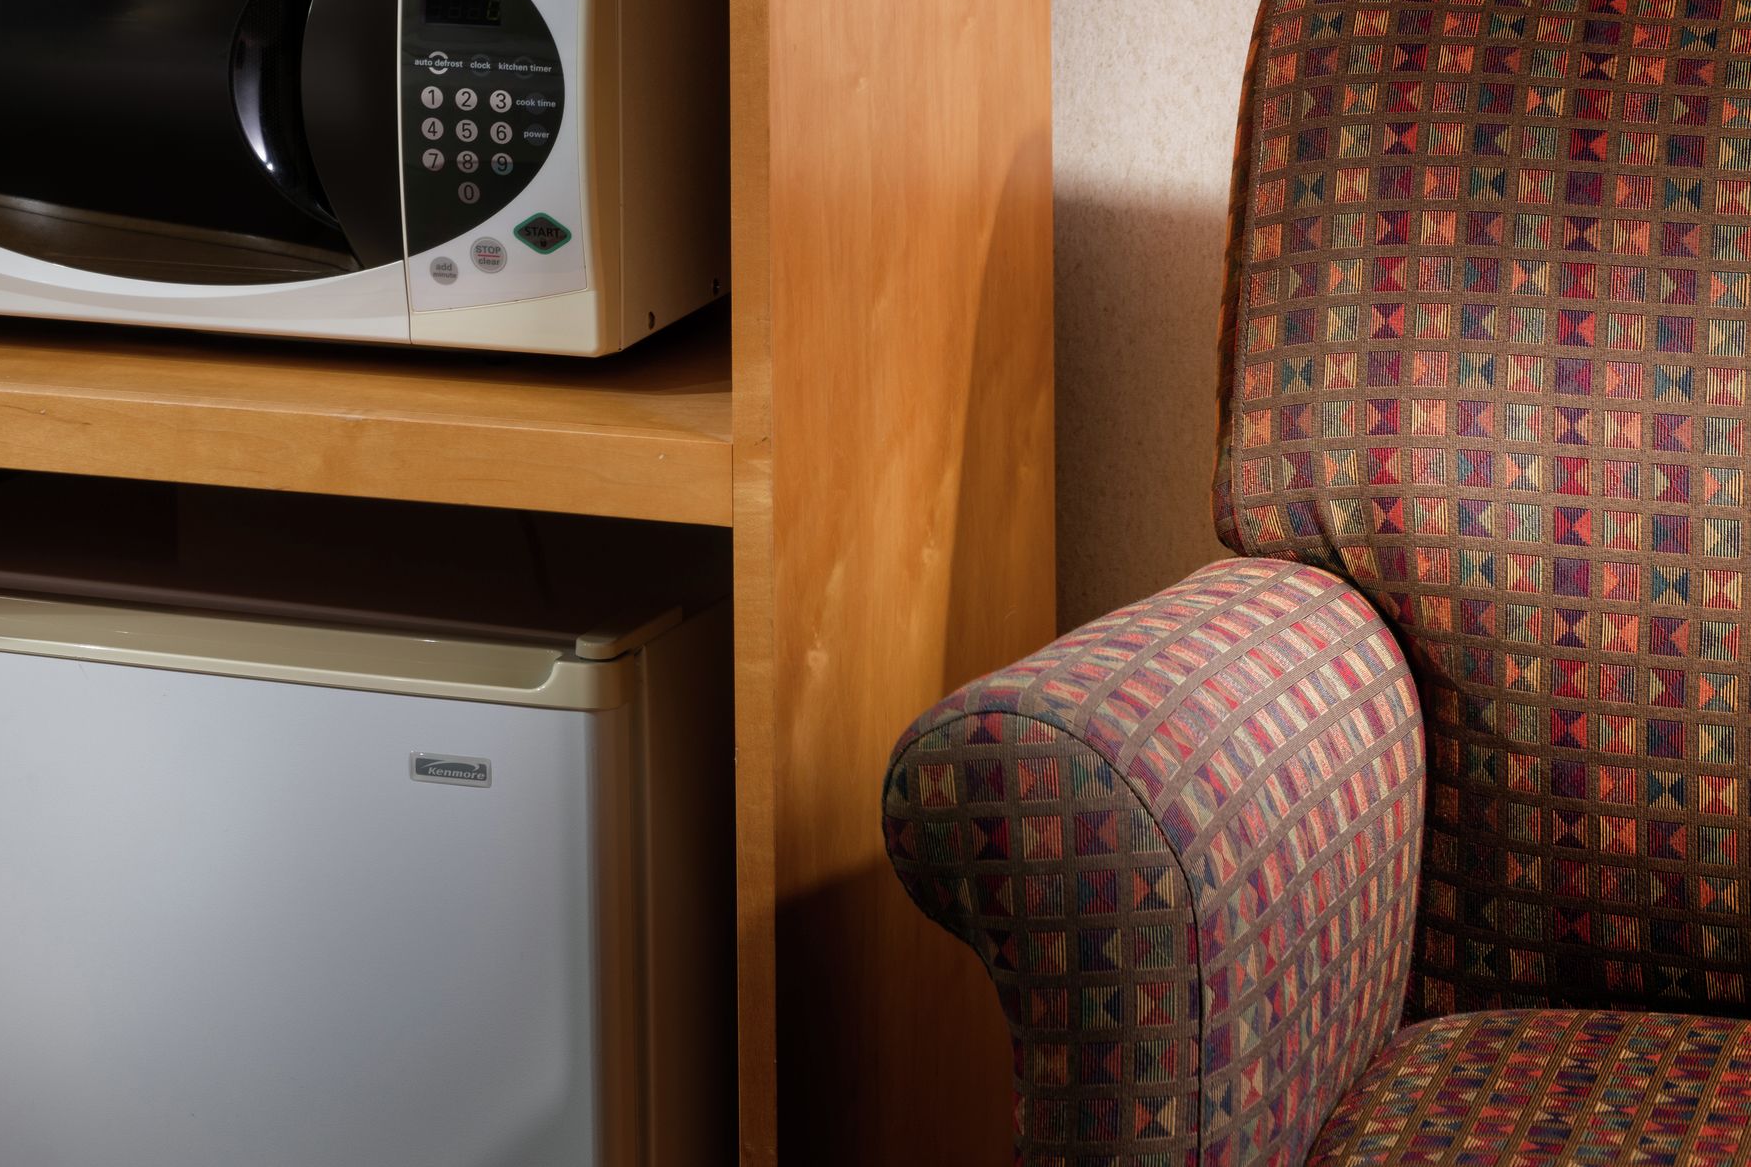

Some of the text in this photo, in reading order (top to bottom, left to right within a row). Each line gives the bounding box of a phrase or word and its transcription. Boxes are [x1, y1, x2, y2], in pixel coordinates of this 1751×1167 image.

[415, 59, 463, 69] auto defrost
[470, 61, 491, 70] clock
[498, 63, 552, 73] kitchen timer
[428, 90, 436, 106] 1
[461, 91, 472, 108] 2
[495, 93, 507, 110] 3
[516, 98, 556, 109] cook time
[428, 121, 438, 136] 4
[462, 123, 472, 139] 5
[496, 125, 507, 141] 6
[523, 129, 550, 140] power
[428, 153, 439, 169] 7
[462, 154, 473, 170] 8
[497, 156, 508, 172] 9
[463, 185, 474, 201] 0
[524, 227, 561, 238] START
[475, 245, 502, 254] STOP
[436, 264, 453, 272] add
[478, 257, 500, 266] clear
[428, 767, 485, 780] Kenmore
